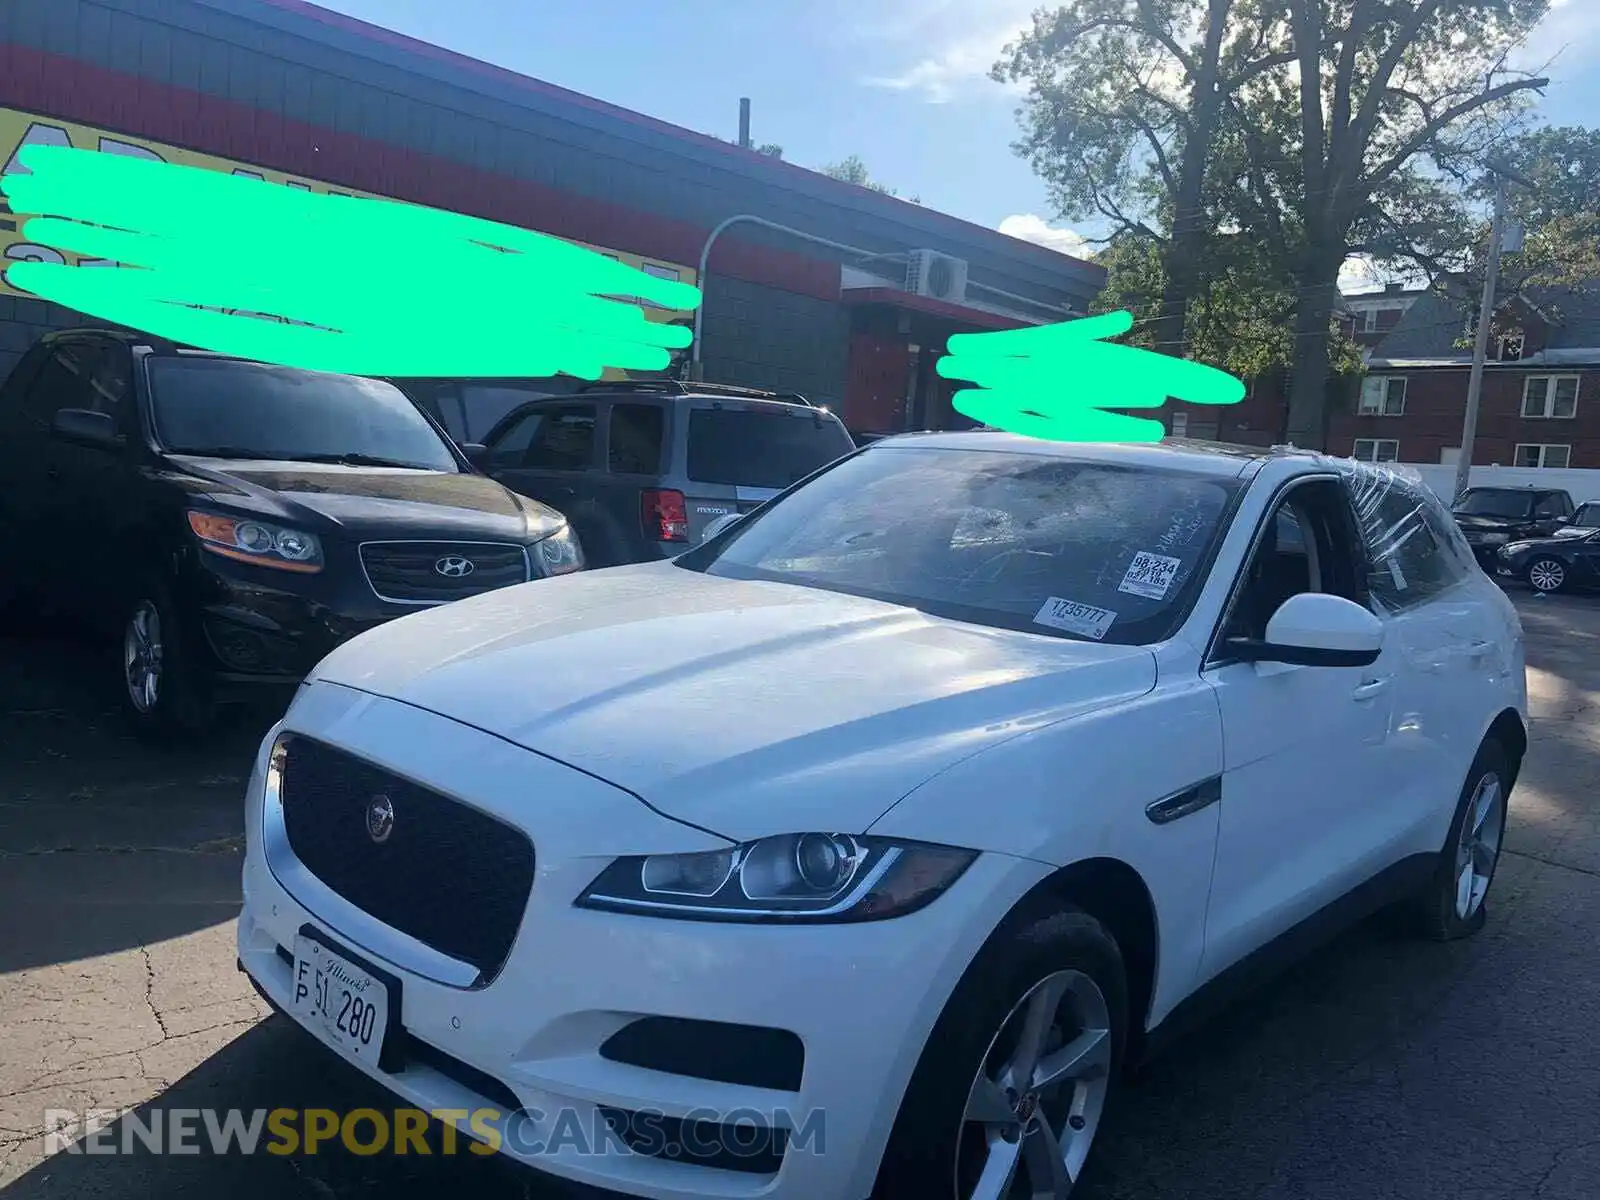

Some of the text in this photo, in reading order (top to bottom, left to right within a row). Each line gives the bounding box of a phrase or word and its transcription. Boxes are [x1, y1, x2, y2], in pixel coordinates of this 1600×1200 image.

[1052, 600, 1106, 621] 1735777
[326, 960, 370, 992] Illinois
[336, 990, 376, 1045] 280
